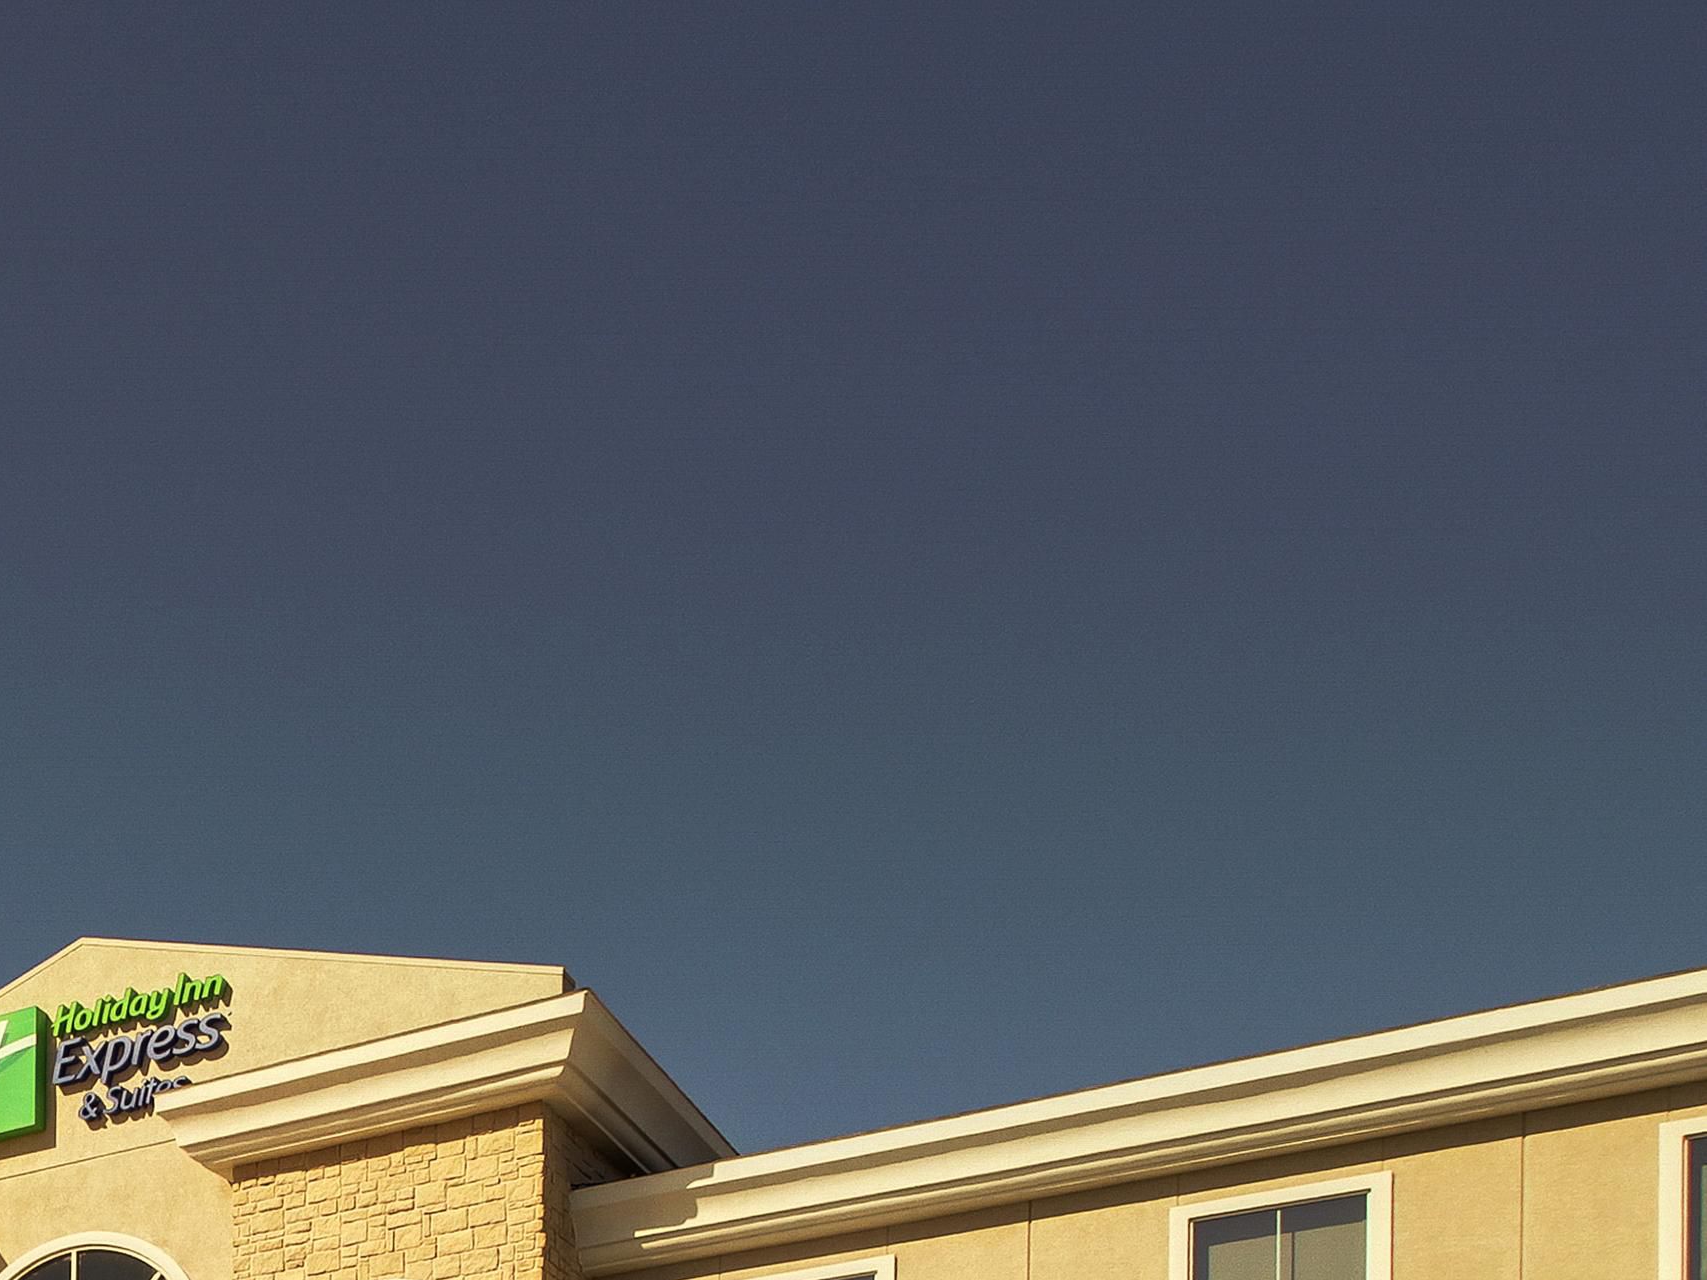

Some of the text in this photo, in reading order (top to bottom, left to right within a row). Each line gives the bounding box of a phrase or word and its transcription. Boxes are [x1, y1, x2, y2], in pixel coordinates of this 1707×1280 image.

[51, 972, 227, 1037] Holiday Inn
[52, 1012, 223, 1085] Express
[79, 1092, 98, 1120] &
